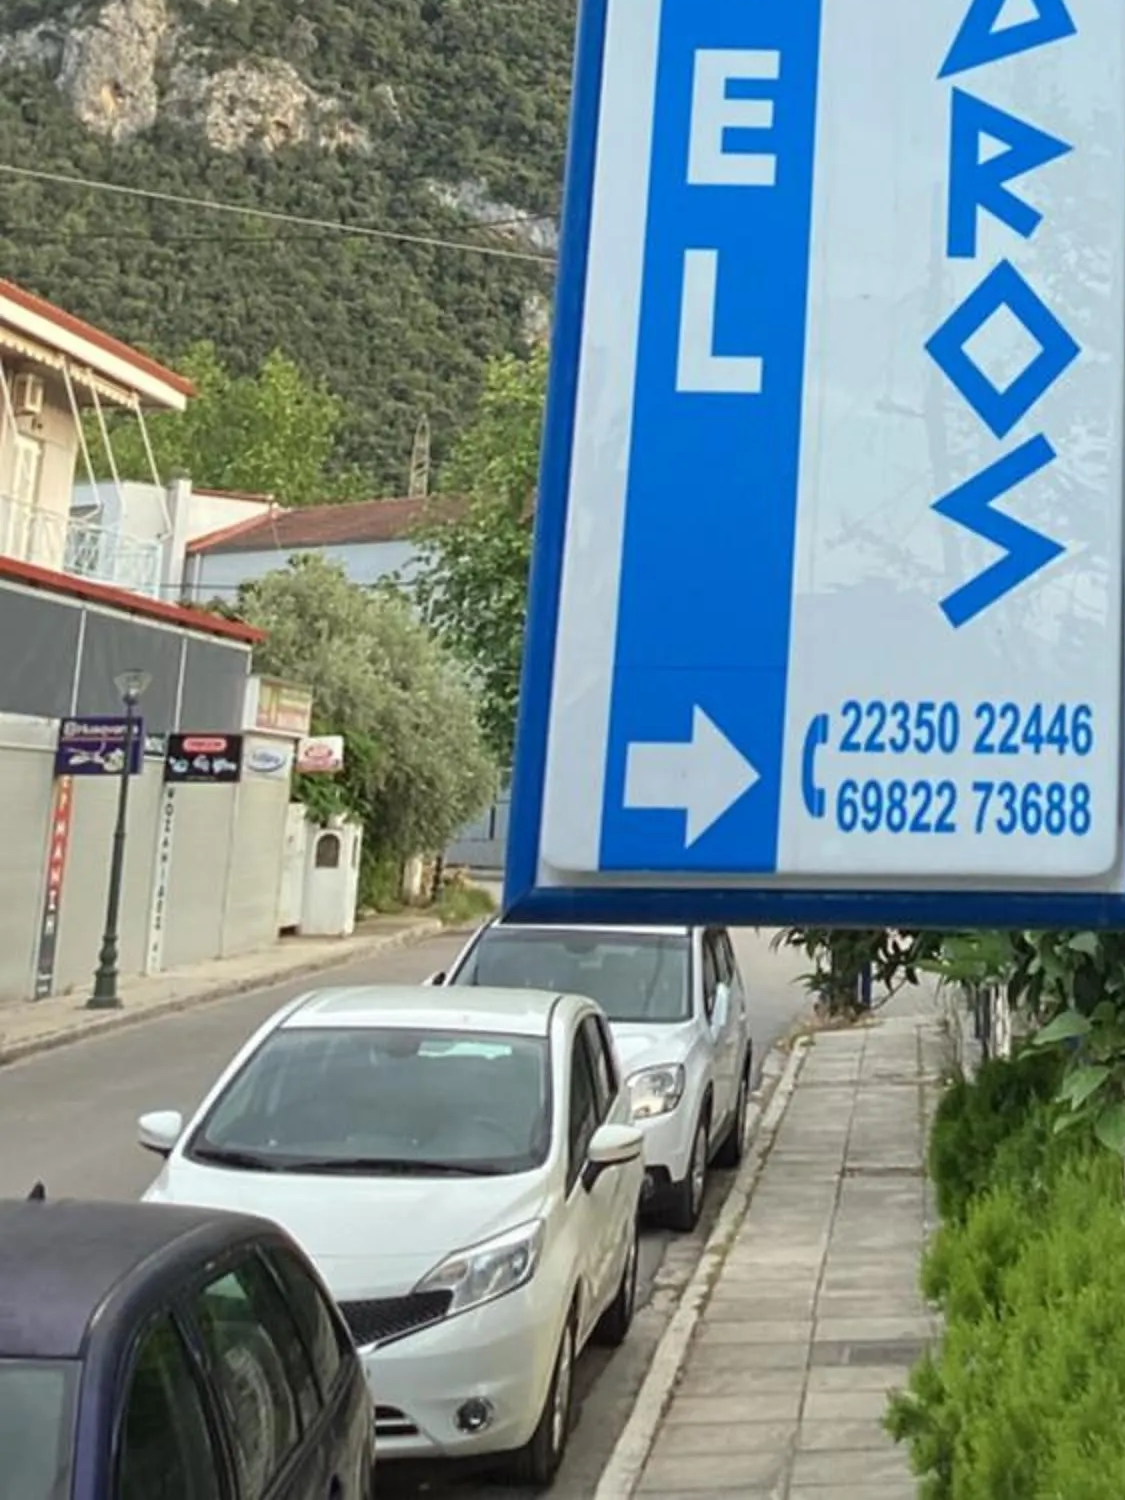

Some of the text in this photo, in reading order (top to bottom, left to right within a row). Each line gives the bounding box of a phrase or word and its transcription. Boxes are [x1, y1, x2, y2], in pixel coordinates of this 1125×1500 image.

[839, 699, 1094, 756] 22350 22446
[836, 778, 1092, 836] 69822 73688
